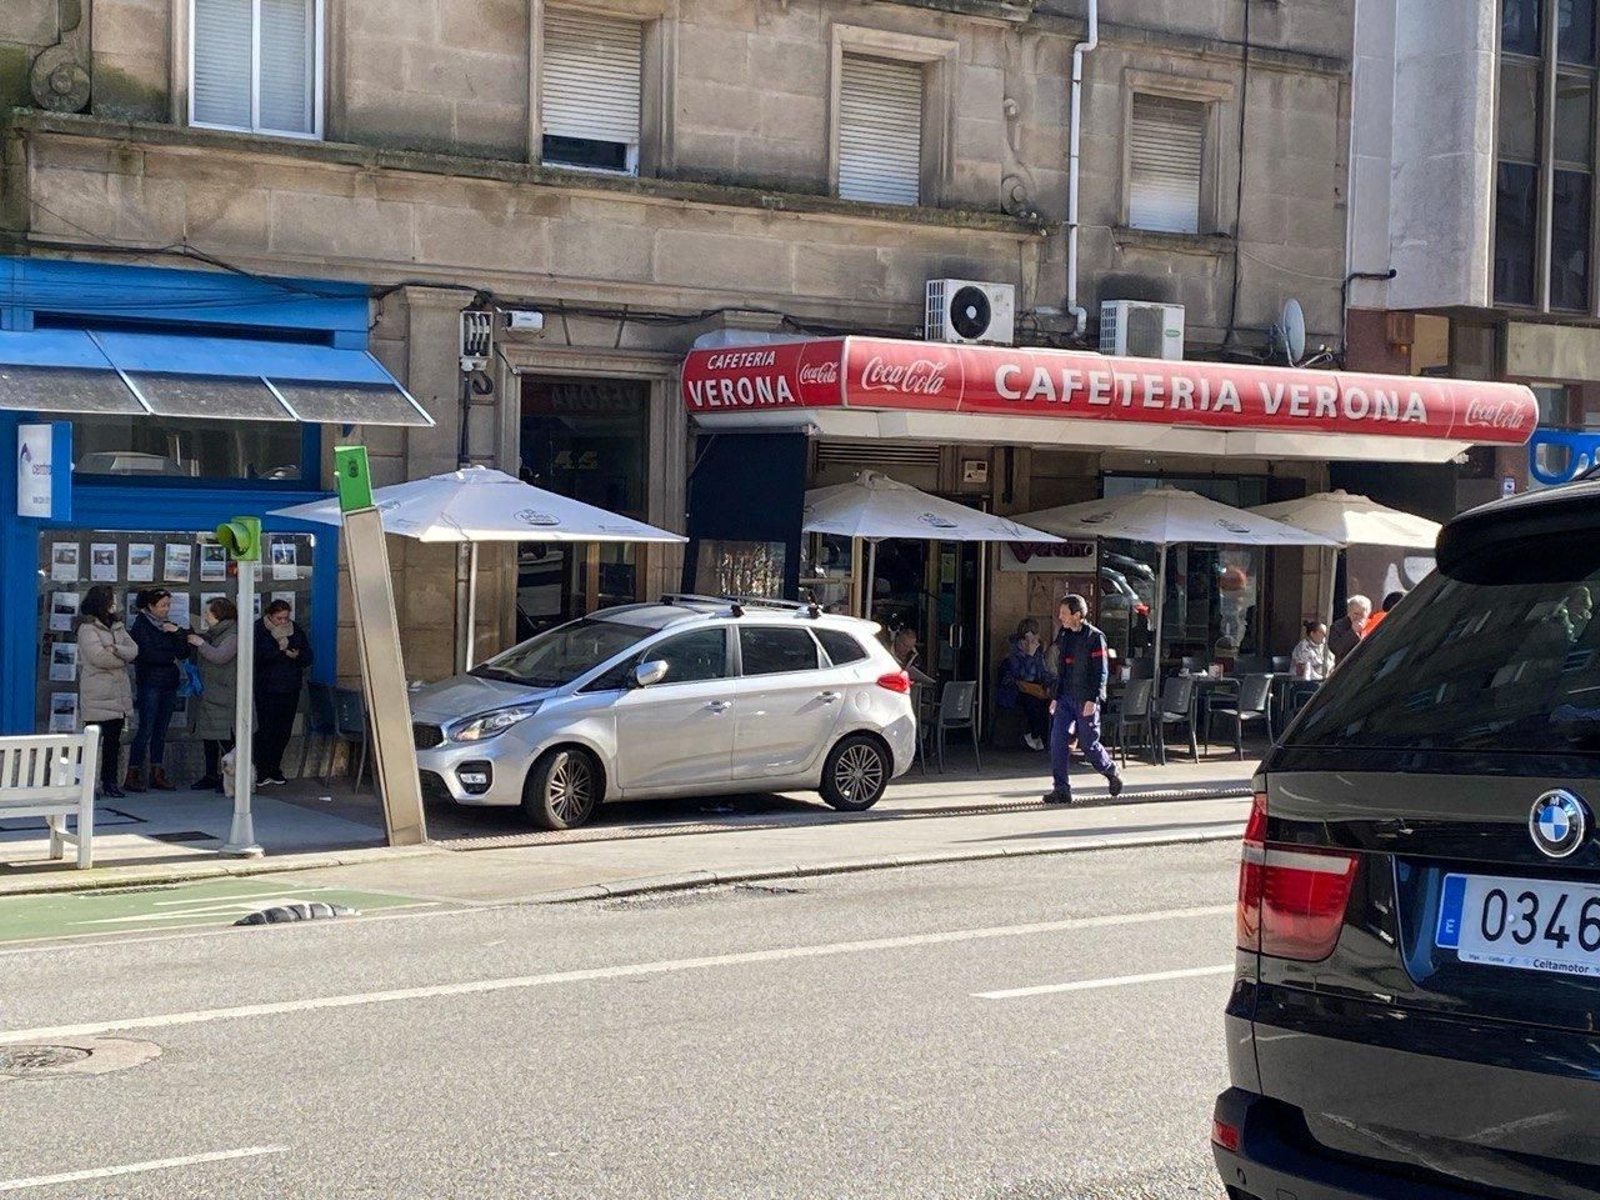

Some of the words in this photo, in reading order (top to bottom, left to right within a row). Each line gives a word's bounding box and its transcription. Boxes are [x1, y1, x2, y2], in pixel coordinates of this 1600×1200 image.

[707, 350, 776, 370] CAFETERIA
[861, 355, 946, 395] Coca-Cola
[688, 374, 796, 407] VERONA
[995, 364, 1242, 414] CAFETERIA
[1258, 381, 1428, 424] VERONA
[1445, 918, 1456, 934] E
[1480, 888, 1600, 953] 0346
[1533, 957, 1590, 974] Celtamotor
